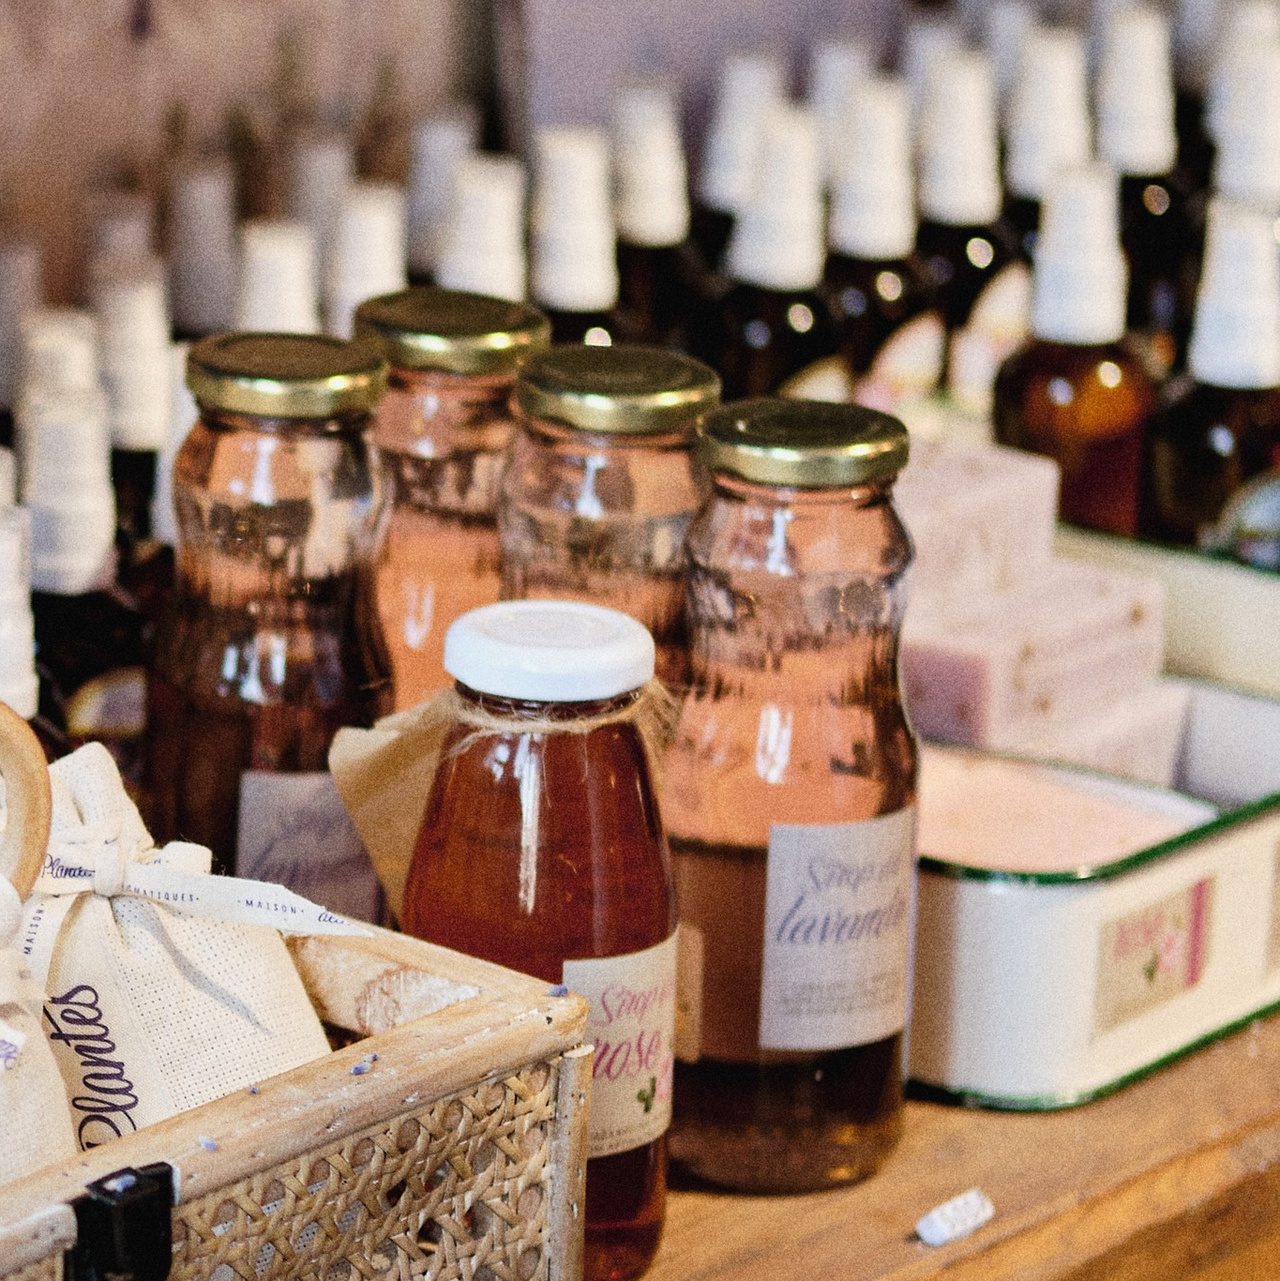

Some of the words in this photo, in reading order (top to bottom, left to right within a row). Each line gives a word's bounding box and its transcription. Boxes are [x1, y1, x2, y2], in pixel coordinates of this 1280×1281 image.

[245, 898, 298, 915] MAISON
[23, 907, 45, 956] MAISON
[43, 983, 139, 1154] Plantes
